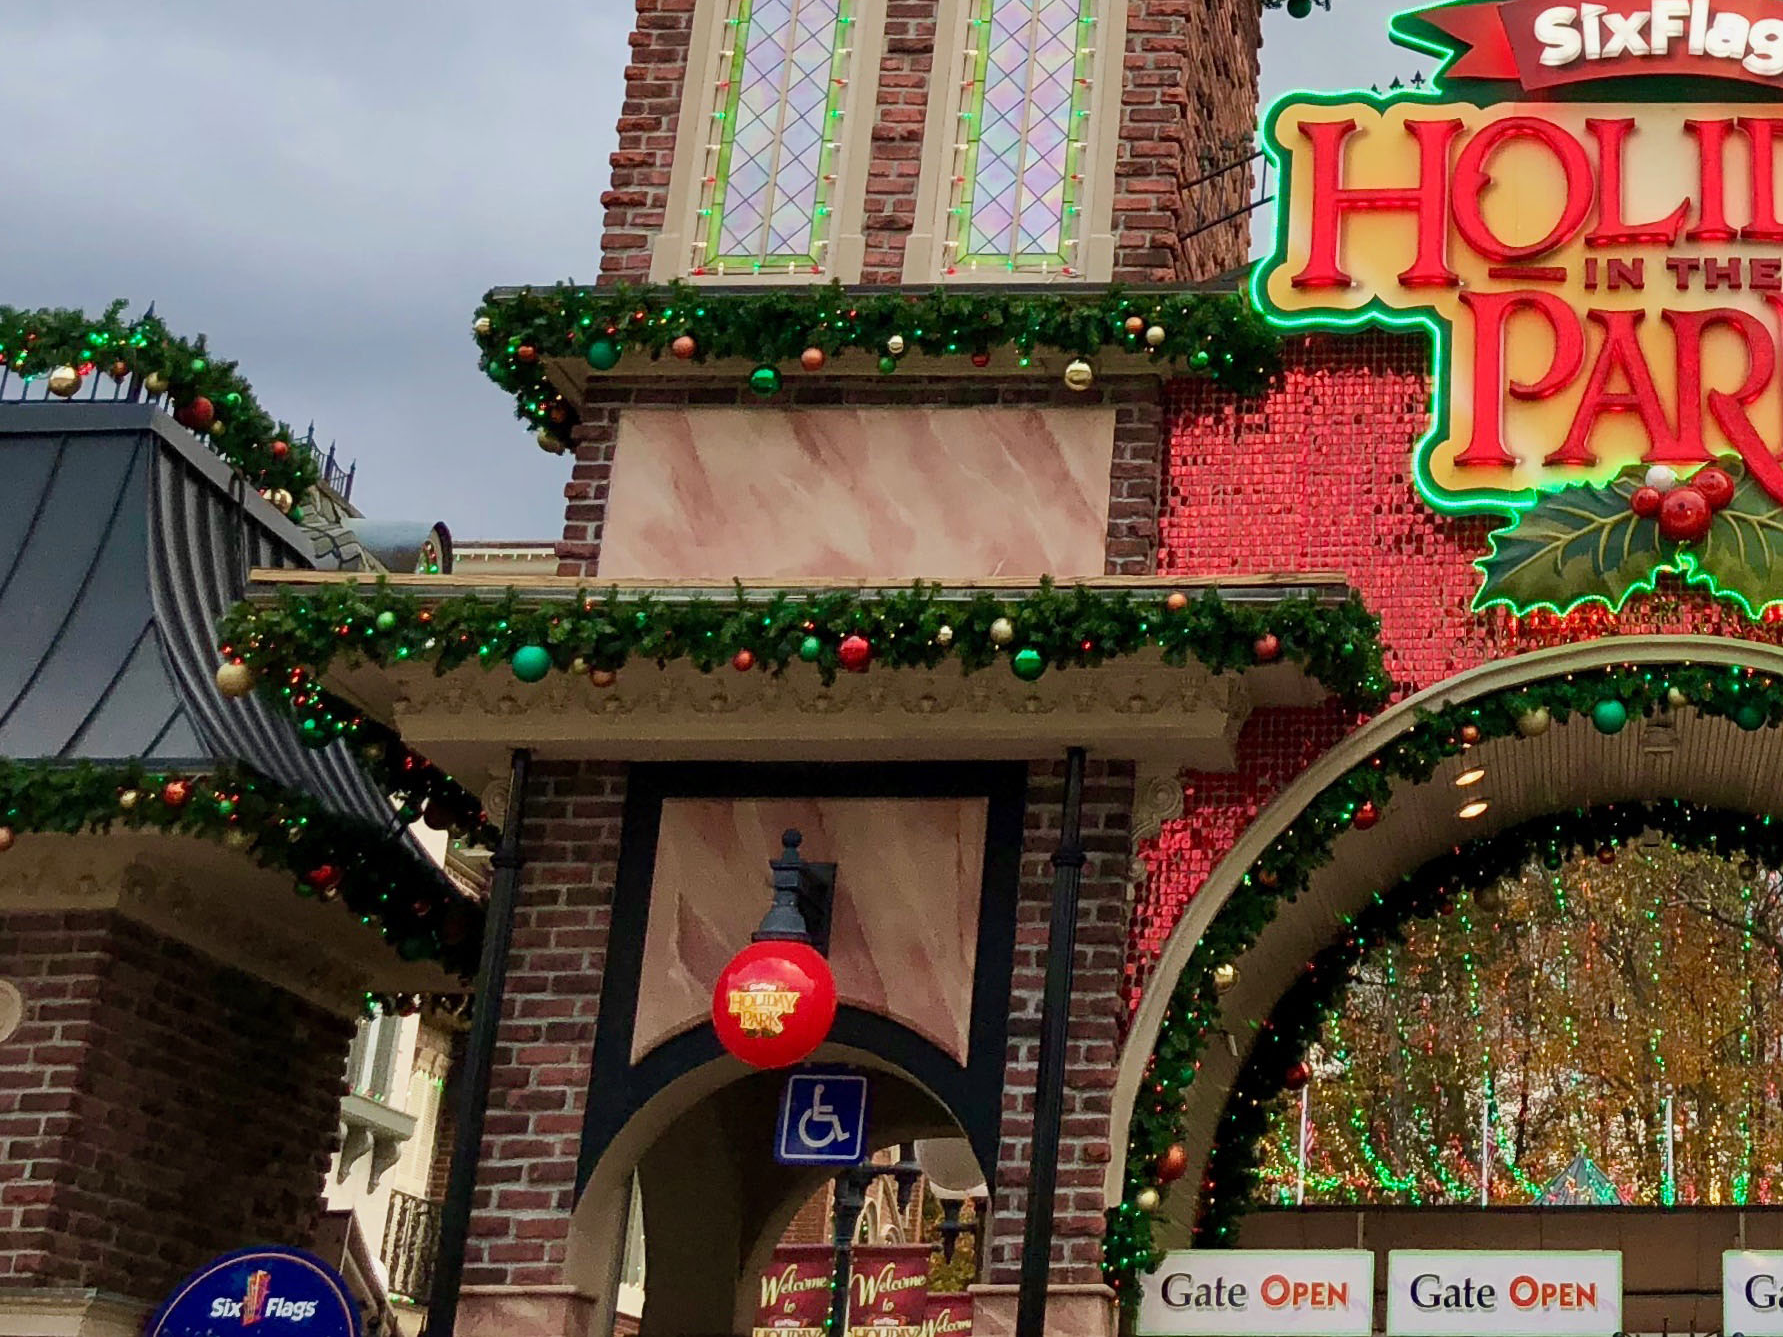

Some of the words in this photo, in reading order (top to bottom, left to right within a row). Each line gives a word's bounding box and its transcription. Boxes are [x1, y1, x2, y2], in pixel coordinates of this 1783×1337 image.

[1584, 257, 1645, 290] IN
[1666, 257, 1783, 290] THE
[730, 992, 796, 1012] HOLIDAY
[742, 1010, 782, 1031] PARK
[760, 1264, 828, 1308] Welcome
[850, 1262, 927, 1307] Welcome
[1161, 1273, 1248, 1307] Gate
[1261, 1274, 1348, 1306] OPEN
[1410, 1273, 1495, 1308] Gate
[1509, 1275, 1597, 1306] OPEN
[210, 1297, 244, 1317] Six
[265, 1297, 317, 1321] Flags
[920, 1309, 972, 1337] Welcom
